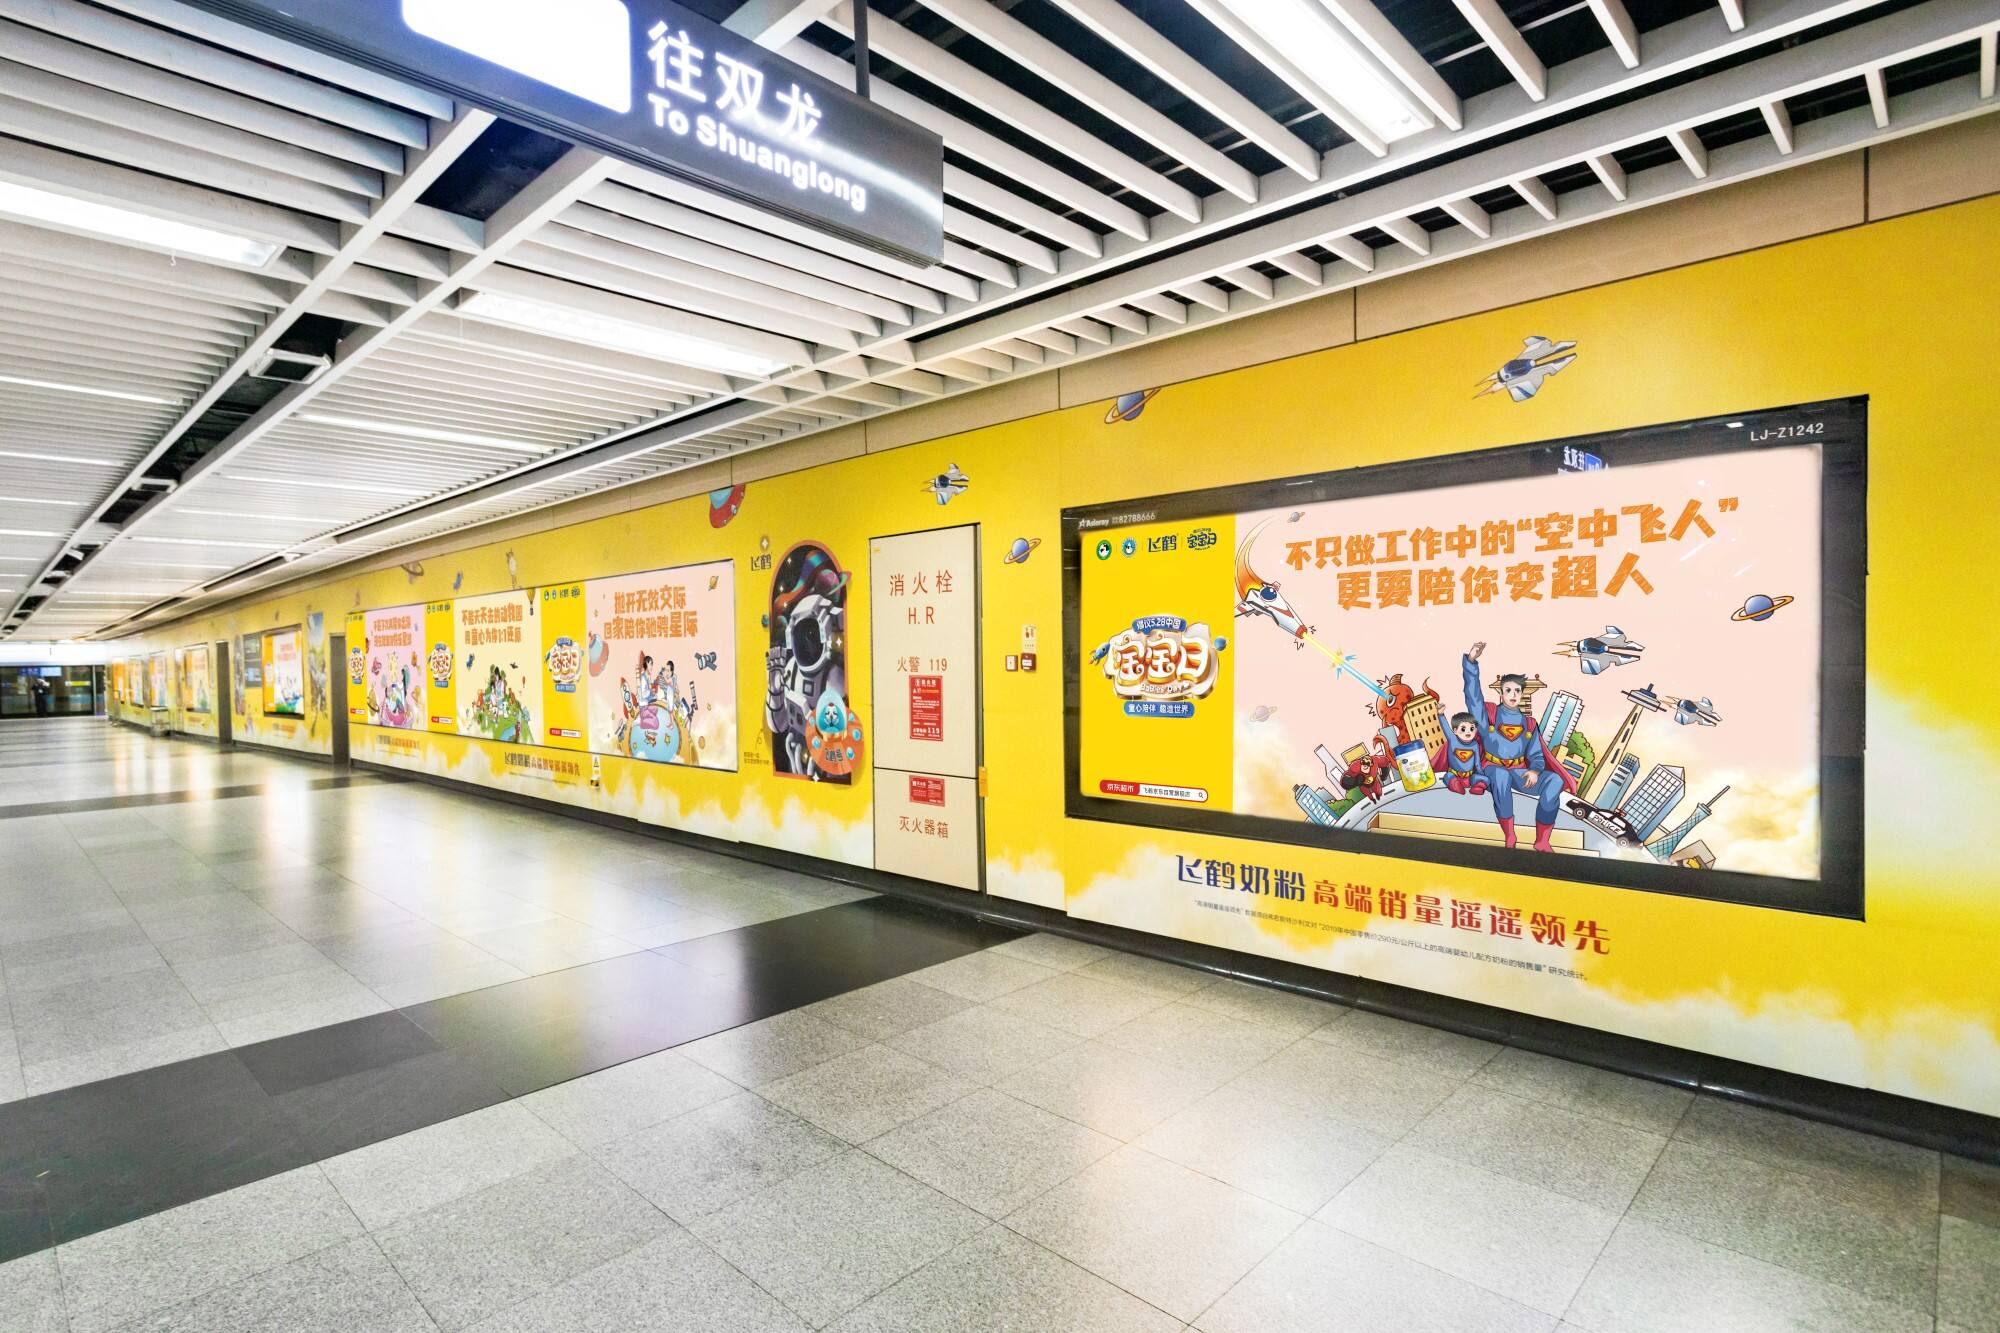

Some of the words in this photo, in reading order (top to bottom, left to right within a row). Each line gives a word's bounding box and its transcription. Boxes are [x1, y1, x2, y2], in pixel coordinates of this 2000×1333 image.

[648, 20, 822, 148] 往双龙
[648, 94, 690, 135] To
[696, 115, 867, 211] Shuanglong
[1750, 422, 1824, 442] LJ-Z1242
[614, 584, 687, 614] 抛开无效交际
[890, 570, 953, 597] 消火栓
[1337, 552, 1655, 611] 更要陪你变超人
[897, 656, 920, 673] 火警
[929, 658, 948, 672] 119
[1112, 634, 1210, 682] 宝宝日
[899, 815, 949, 839] 灭火器箱
[1176, 855, 1306, 902] 飞鹤奶粉
[1313, 879, 1611, 956] 高端销量遥遥领先
